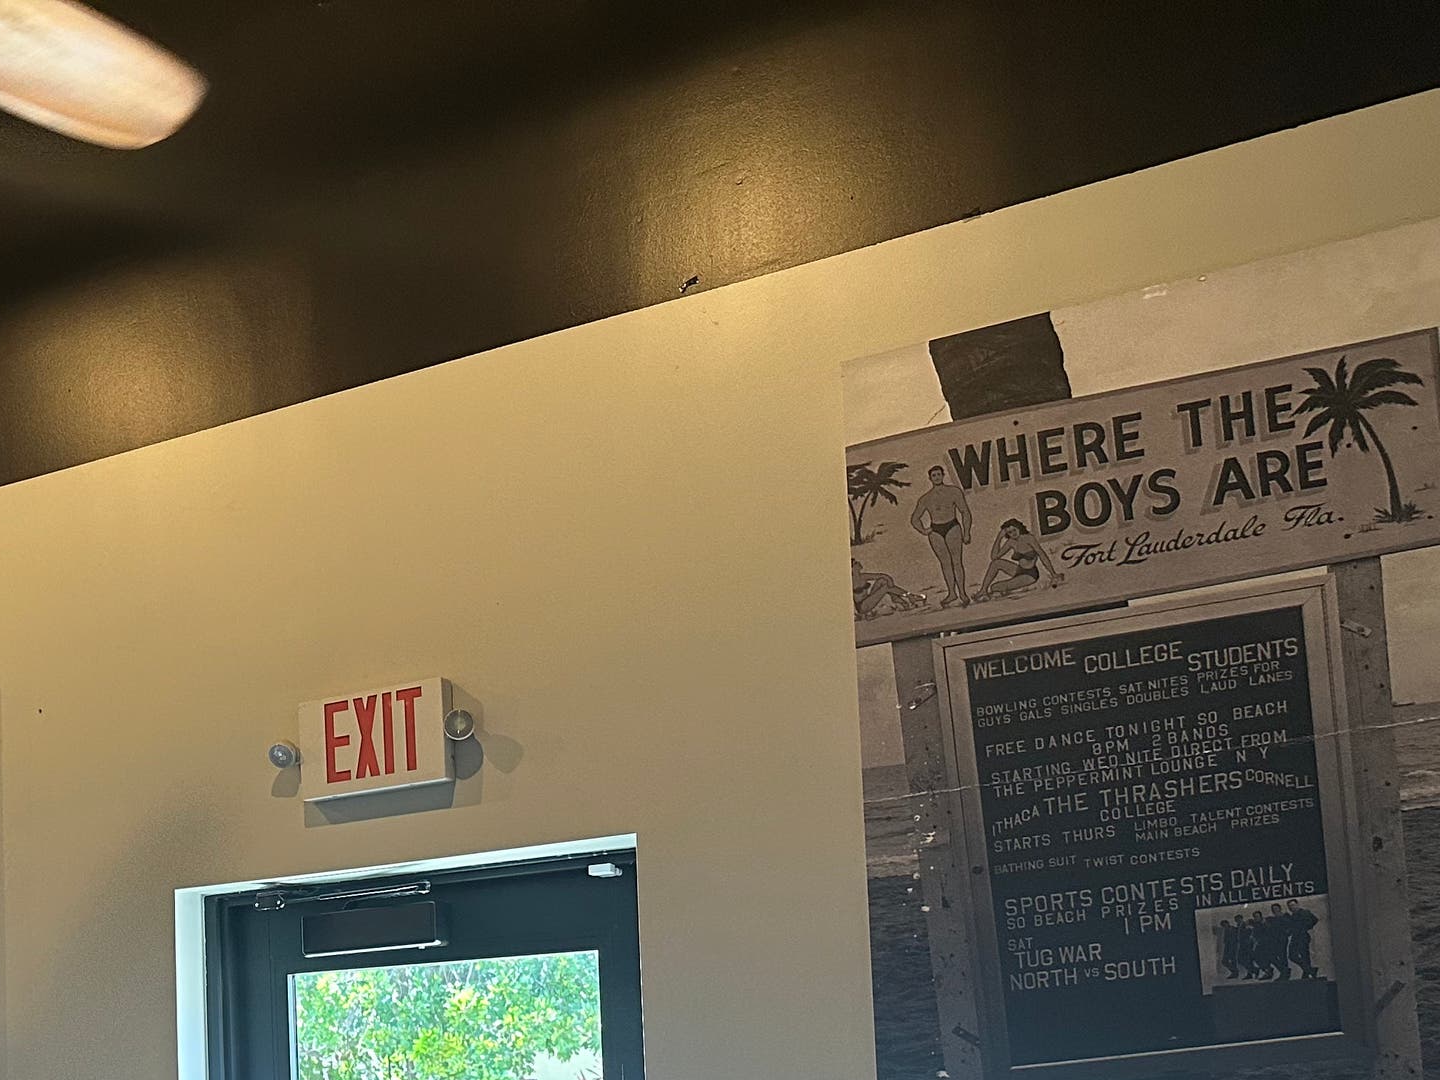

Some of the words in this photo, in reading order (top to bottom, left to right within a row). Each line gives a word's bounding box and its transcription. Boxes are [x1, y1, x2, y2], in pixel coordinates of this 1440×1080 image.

[948, 412, 1146, 490] WHERE
[1177, 384, 1300, 448] THE
[1036, 469, 1181, 536] BOYS
[1213, 441, 1328, 506] ARE
[1061, 542, 1116, 568] Fort
[1116, 515, 1266, 566] Lauderdale
[1281, 502, 1345, 531] Fla.
[973, 648, 1076, 680] WELCOME
[1084, 641, 1183, 673] COLLEGE
[1187, 637, 1298, 672] STUDENTS
[976, 700, 1037, 717] BOWLING
[1043, 687, 1111, 706] CONTESTS
[1119, 681, 1143, 695] SAT
[1148, 675, 1188, 690] NITES
[1197, 665, 1249, 682] PRIZES
[1254, 660, 1280, 673] FOR
[978, 714, 1011, 728] GUYS
[1019, 707, 1052, 721] GALS
[1061, 697, 1118, 715] SINGLES
[1127, 686, 1189, 705] DOUBLES
[1200, 679, 1237, 694] LAUD
[1249, 670, 1293, 686] LANES
[324, 686, 422, 784] EXIT
[985, 740, 1027, 758] FREE
[1035, 729, 1096, 750] DANCE
[1105, 716, 1185, 739] TONIGHT
[1197, 711, 1218, 726] SO
[1233, 700, 1287, 720] BEACH
[1168, 723, 1229, 745] BANDS
[991, 761, 1071, 785] STARTING
[1082, 754, 1119, 771] WED
[1125, 748, 1162, 766] NITE
[1171, 737, 1233, 758] DIRECT
[1241, 729, 1287, 748] FROM
[993, 782, 1025, 798] THE
[1034, 765, 1143, 792] PEPPERMINT
[1151, 754, 1218, 775] LOUNGE
[1236, 750, 1247, 763] N
[1259, 746, 1269, 759] Y
[992, 805, 1040, 837] ITHACA
[1043, 792, 1089, 816] THE
[1099, 771, 1243, 808] THRASHERS
[1245, 768, 1314, 789] CORNELL
[1100, 800, 1176, 822] COLLEGE
[1134, 816, 1177, 831] LIMBO
[1190, 807, 1242, 824] TALENT
[1246, 798, 1314, 816] CONTESTS
[994, 834, 1051, 853] STARTS
[1062, 825, 1116, 844] THURS
[1135, 829, 1168, 843] MAIN
[1174, 822, 1217, 837] BEACH
[1231, 813, 1280, 829] PRIZES
[994, 859, 1044, 875] BATHING
[1048, 854, 1077, 868] SUIT
[1084, 854, 1125, 869] TWIST
[1130, 848, 1200, 866] CONTESTS
[1005, 889, 1093, 917] SPORTS
[1101, 872, 1223, 905] CONTESTS
[1231, 863, 1294, 889] DAILY
[1196, 894, 1212, 907] IN
[1219, 890, 1247, 904] ALL
[1252, 881, 1315, 900] EVENTS
[1007, 916, 1025, 930] SO
[1034, 909, 1086, 927] BEACH
[1101, 898, 1179, 919] PRIZES
[1139, 913, 1172, 933] PM
[1008, 937, 1033, 951] SAT
[1014, 949, 1054, 969] TUG
[1059, 943, 1102, 964] WAR
[1010, 968, 1078, 991] NORTH
[1104, 956, 1177, 981] SOUTH
